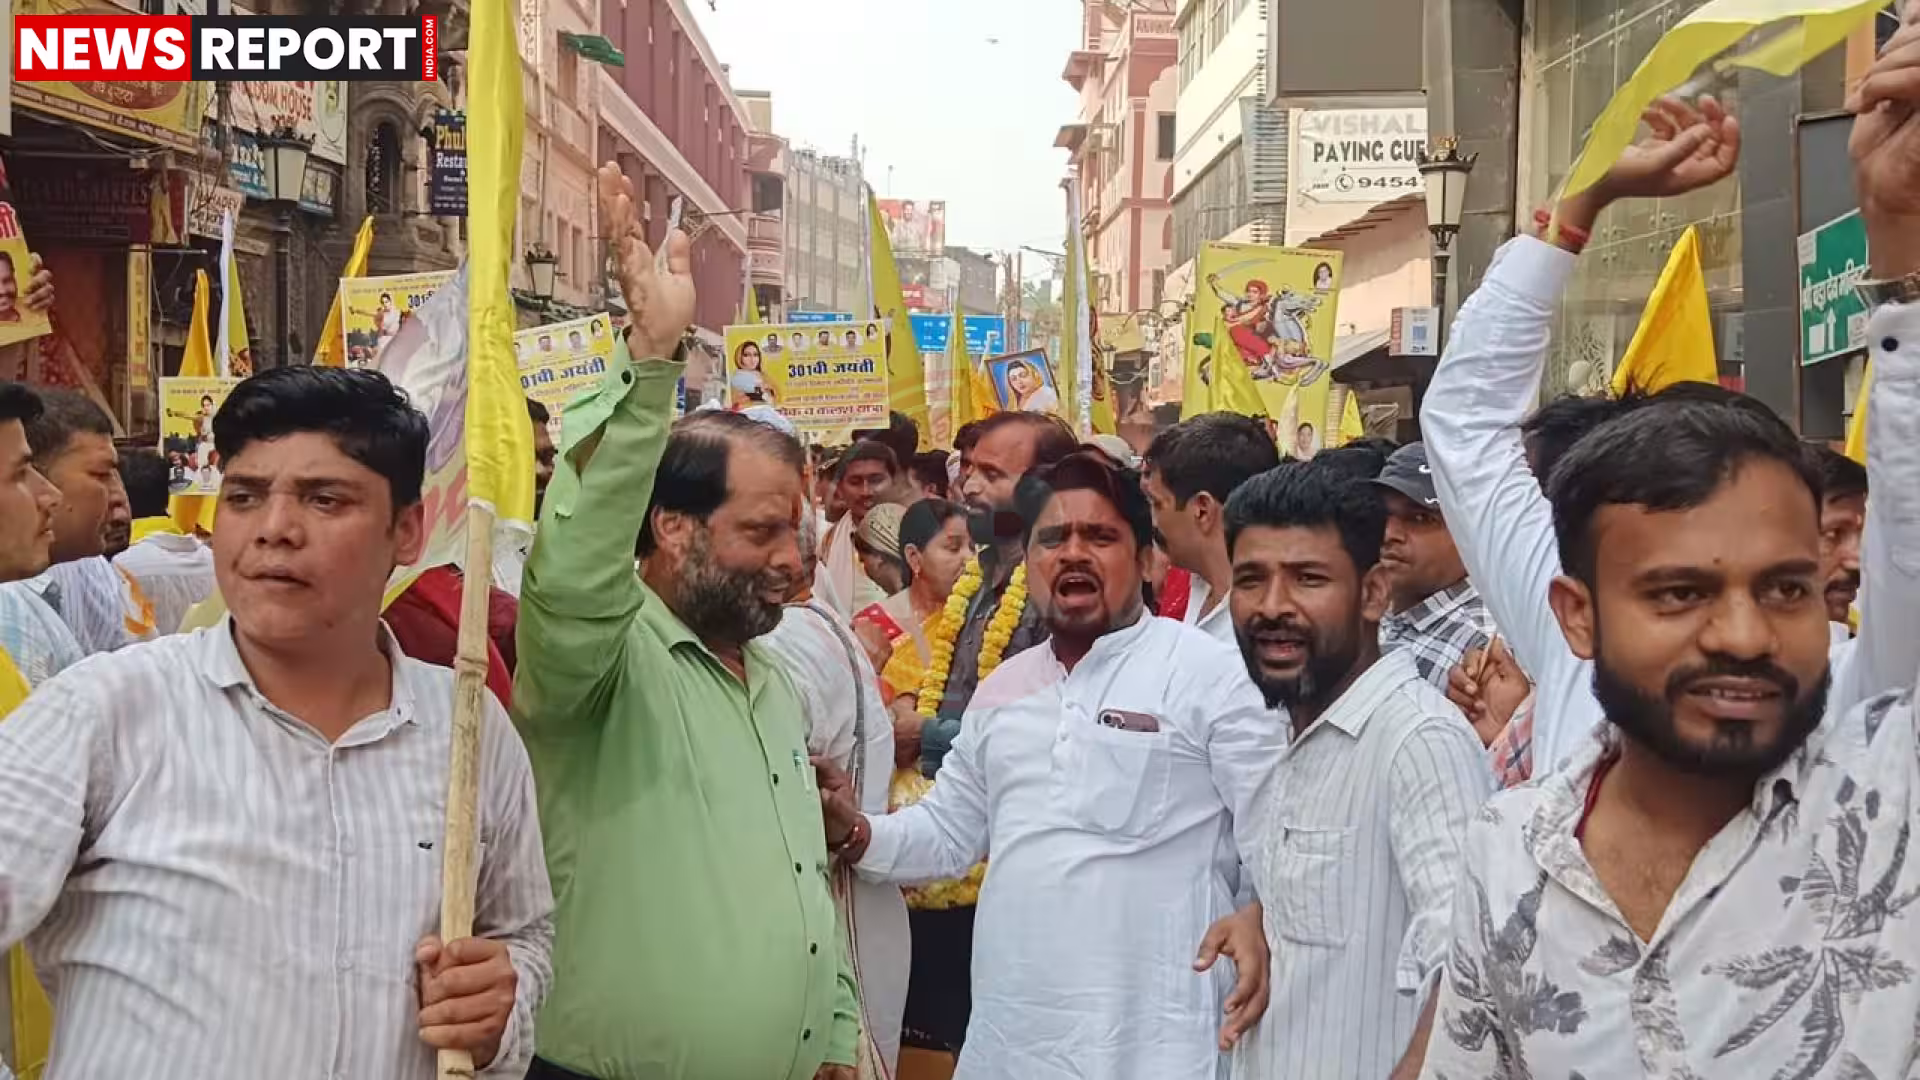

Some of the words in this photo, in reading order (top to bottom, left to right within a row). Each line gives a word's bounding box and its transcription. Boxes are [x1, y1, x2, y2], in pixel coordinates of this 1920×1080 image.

[1312, 114, 1424, 135] VISHAL
[1313, 140, 1384, 162] PAYING
[1358, 177, 1418, 187] 9454
[833, 358, 874, 373] जयंती
